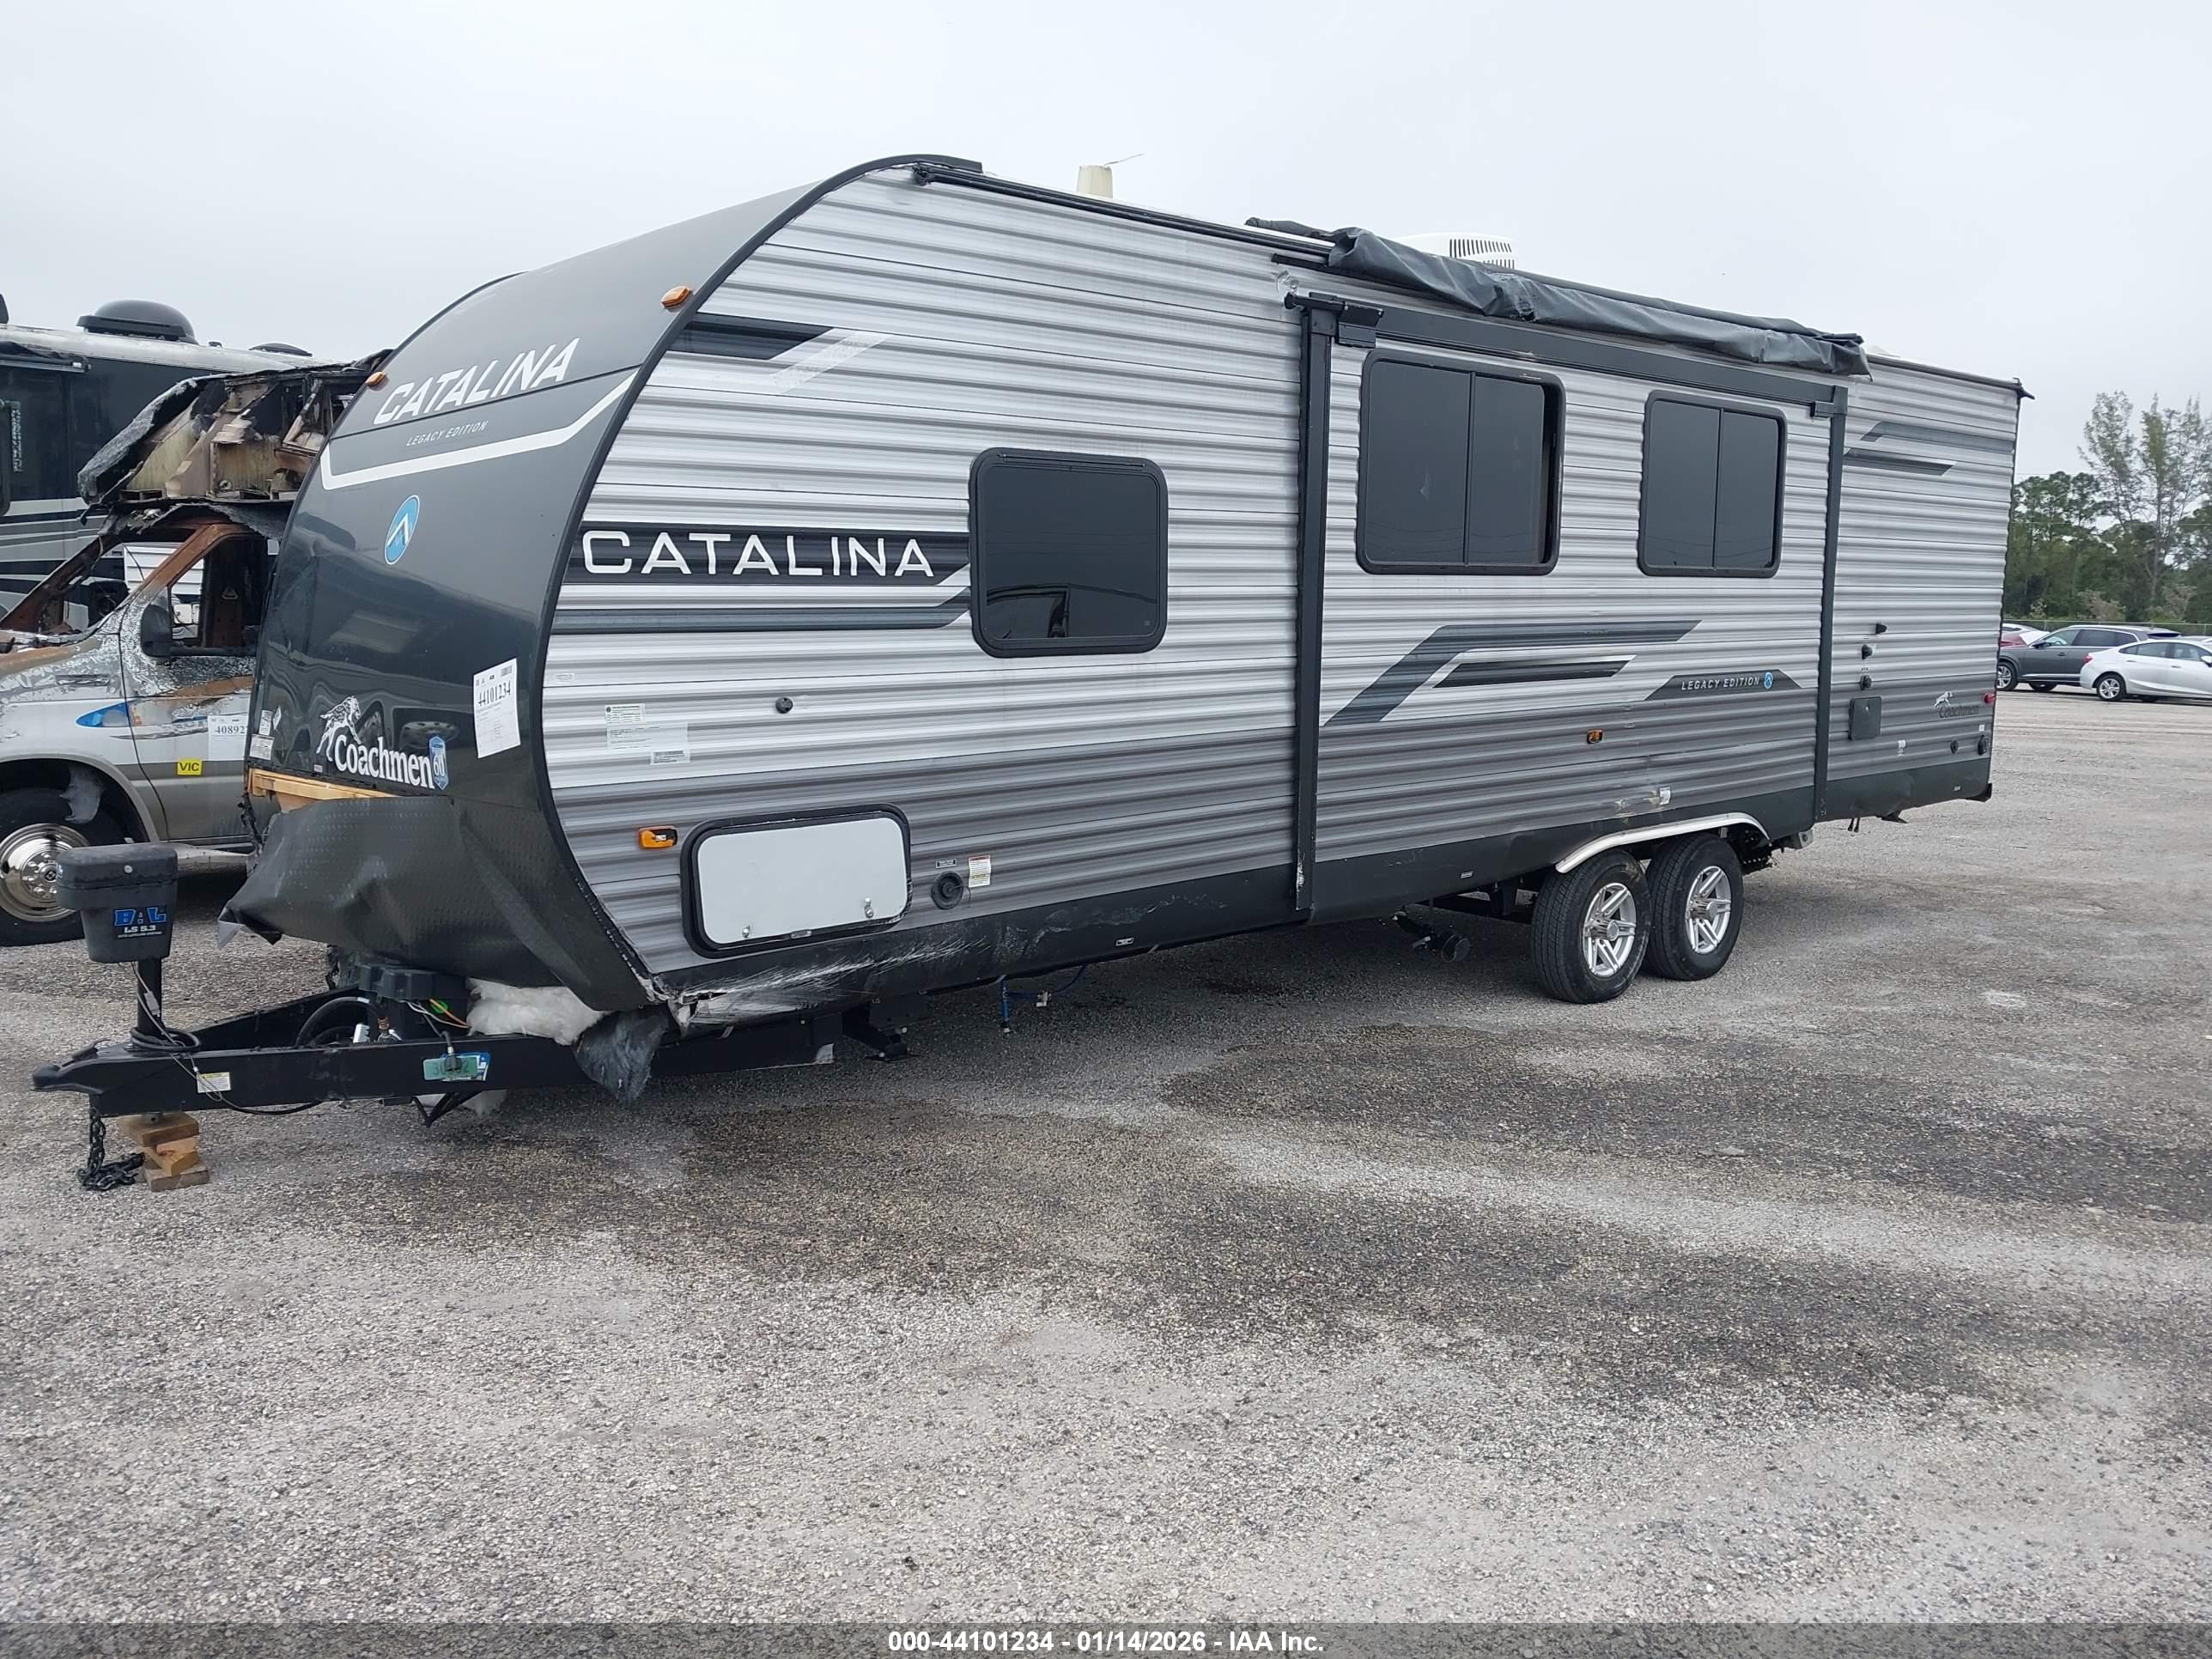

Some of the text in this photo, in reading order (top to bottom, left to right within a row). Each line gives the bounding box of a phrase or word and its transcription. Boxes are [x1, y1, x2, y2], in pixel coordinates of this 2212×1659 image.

[373, 337, 580, 425] CATALINA
[406, 420, 489, 447] LEGACY EDITION
[582, 530, 935, 578] CATALINA
[478, 680, 511, 707] 44101234
[1681, 677, 1760, 690] LEGACY EDITION
[1939, 705, 1979, 718] Coachmen
[215, 725, 248, 734] 40892
[179, 763, 200, 771] VIC
[334, 734, 435, 789] Coachmen
[124, 926, 138, 934] LS
